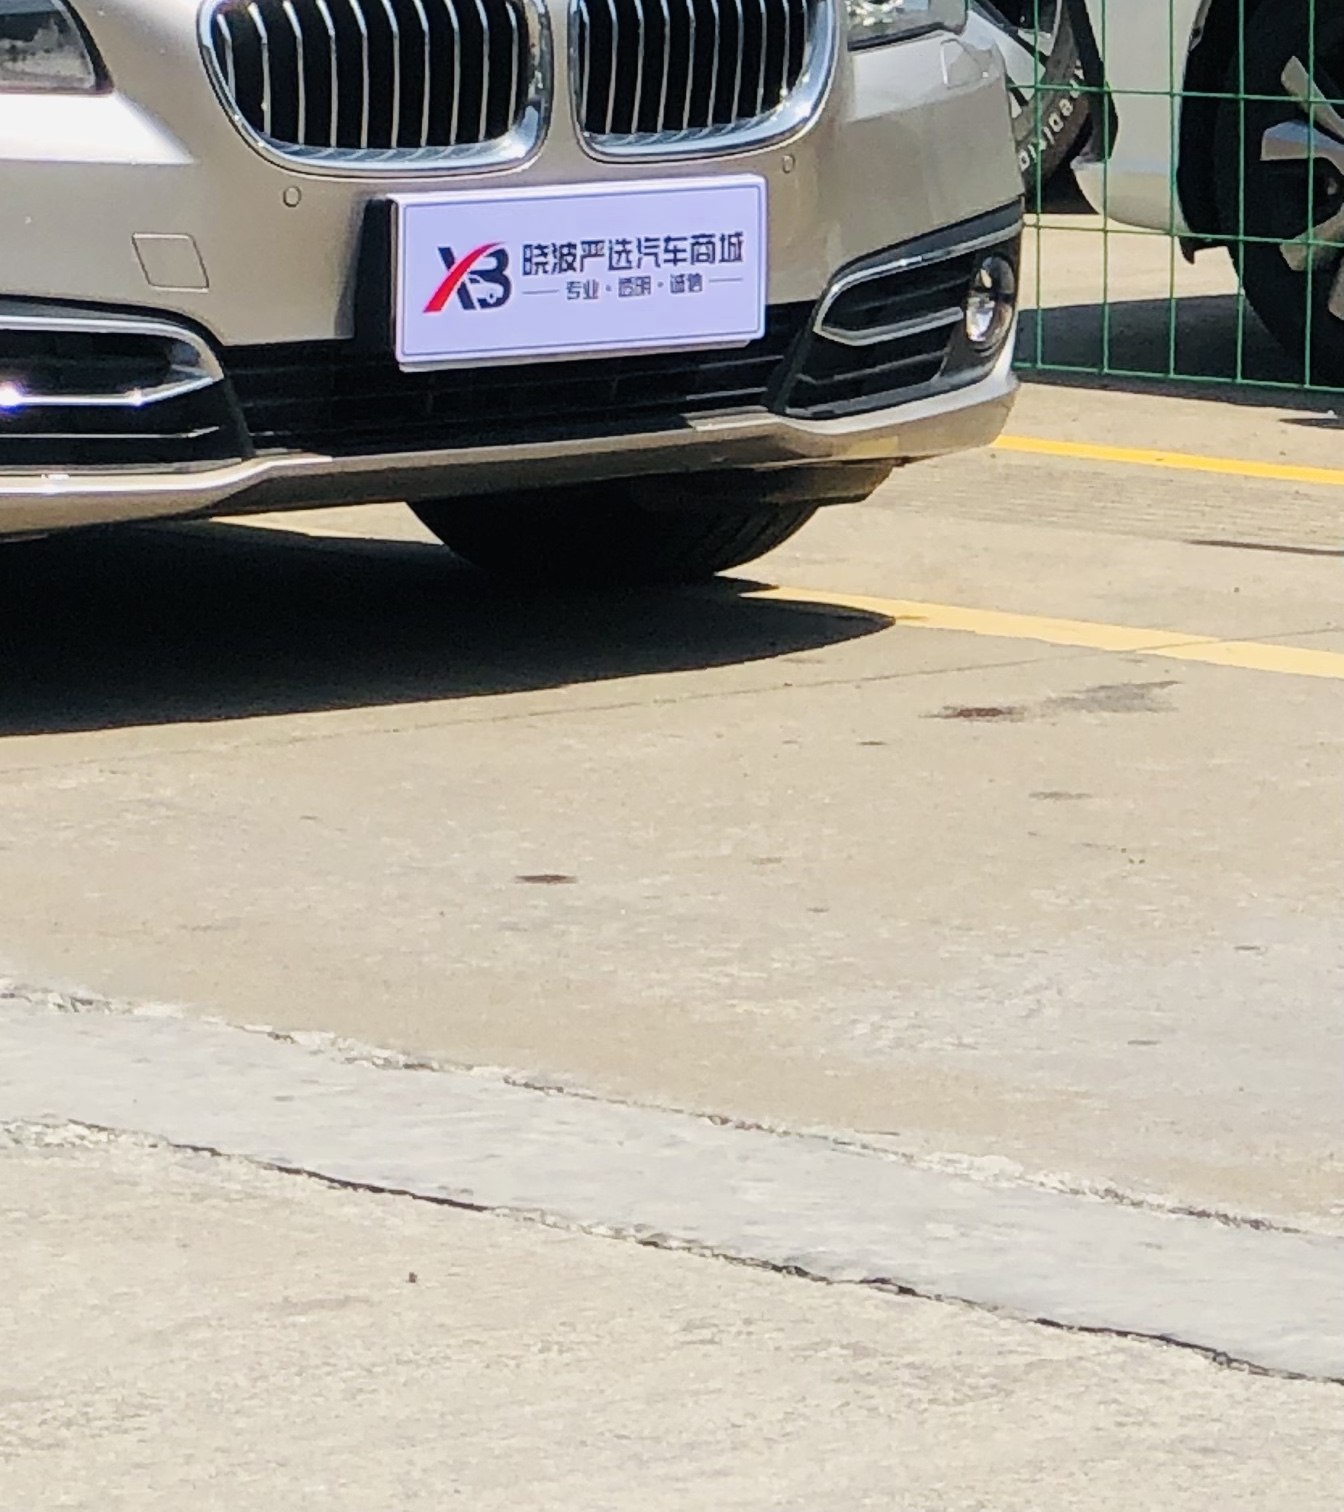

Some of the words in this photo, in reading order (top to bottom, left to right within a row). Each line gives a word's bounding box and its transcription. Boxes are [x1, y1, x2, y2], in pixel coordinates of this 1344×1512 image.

[522, 231, 744, 276] 晓波严选汽车商城
